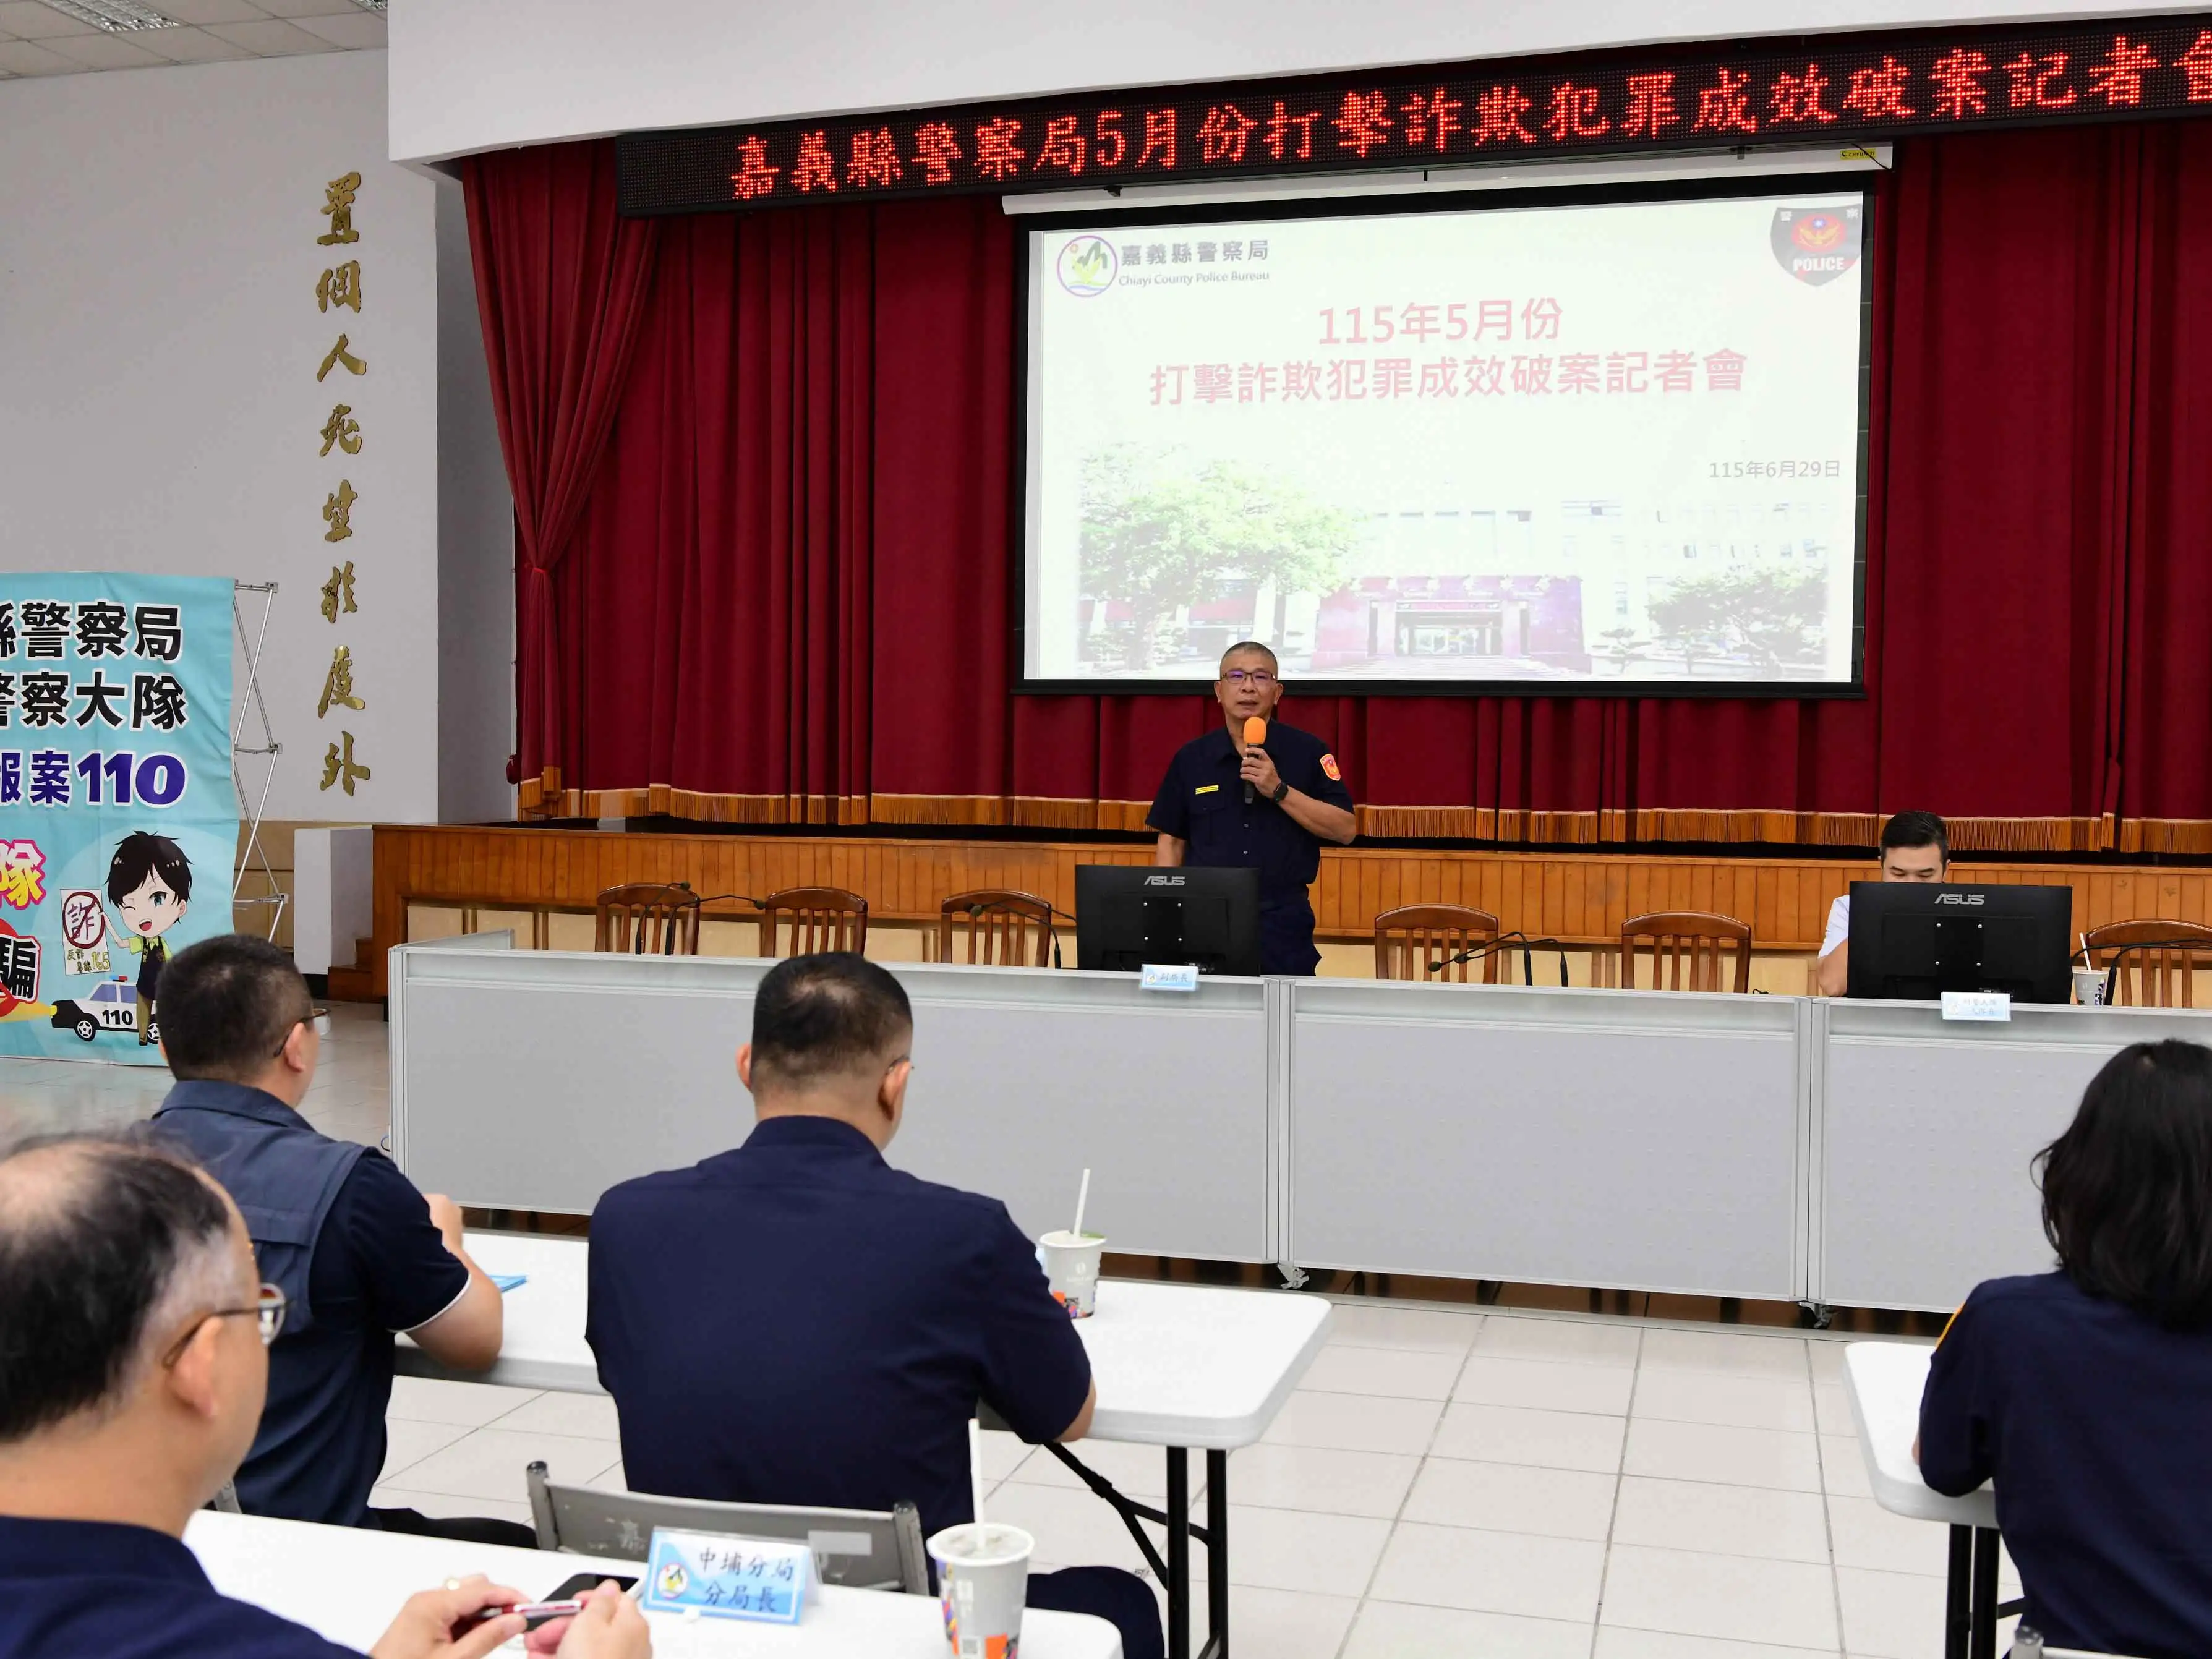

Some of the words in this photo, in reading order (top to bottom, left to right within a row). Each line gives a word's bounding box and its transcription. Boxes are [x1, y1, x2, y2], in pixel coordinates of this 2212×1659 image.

[1121, 239, 1270, 267] 嘉義縣警察局
[1793, 257, 1845, 271] POLICE
[1118, 274, 1152, 287] Chiayi
[1154, 273, 1193, 286] County
[1196, 272, 1229, 283] Police
[1231, 271, 1270, 282] Bureau
[1317, 297, 1564, 345] 115年5月份
[1148, 347, 1749, 406] 打擊詐欺犯罪成效破案記者會
[1709, 459, 1840, 479] 115年6月29日
[316, 171, 371, 797] 置個人死生於度外
[1144, 875, 1186, 887] ASUS
[1934, 893, 1985, 906] ASUS
[102, 1009, 134, 1026] 110
[699, 1546, 796, 1582] 中埔分局
[704, 1580, 778, 1613] 分局長
